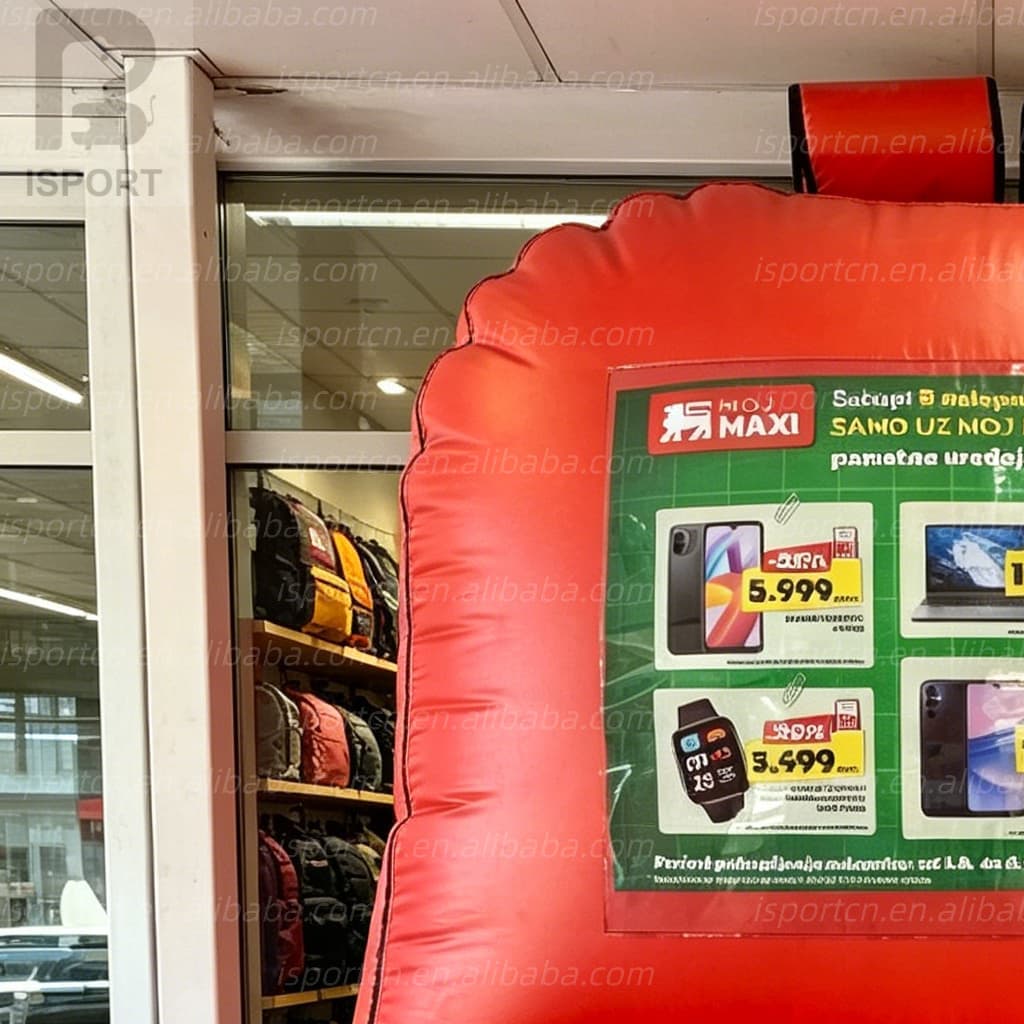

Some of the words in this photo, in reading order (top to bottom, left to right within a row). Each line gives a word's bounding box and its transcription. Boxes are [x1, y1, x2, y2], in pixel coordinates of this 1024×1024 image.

[719, 412, 799, 439] MAXI
[916, 417, 952, 436] UZ
[749, 578, 833, 603] 5.999
